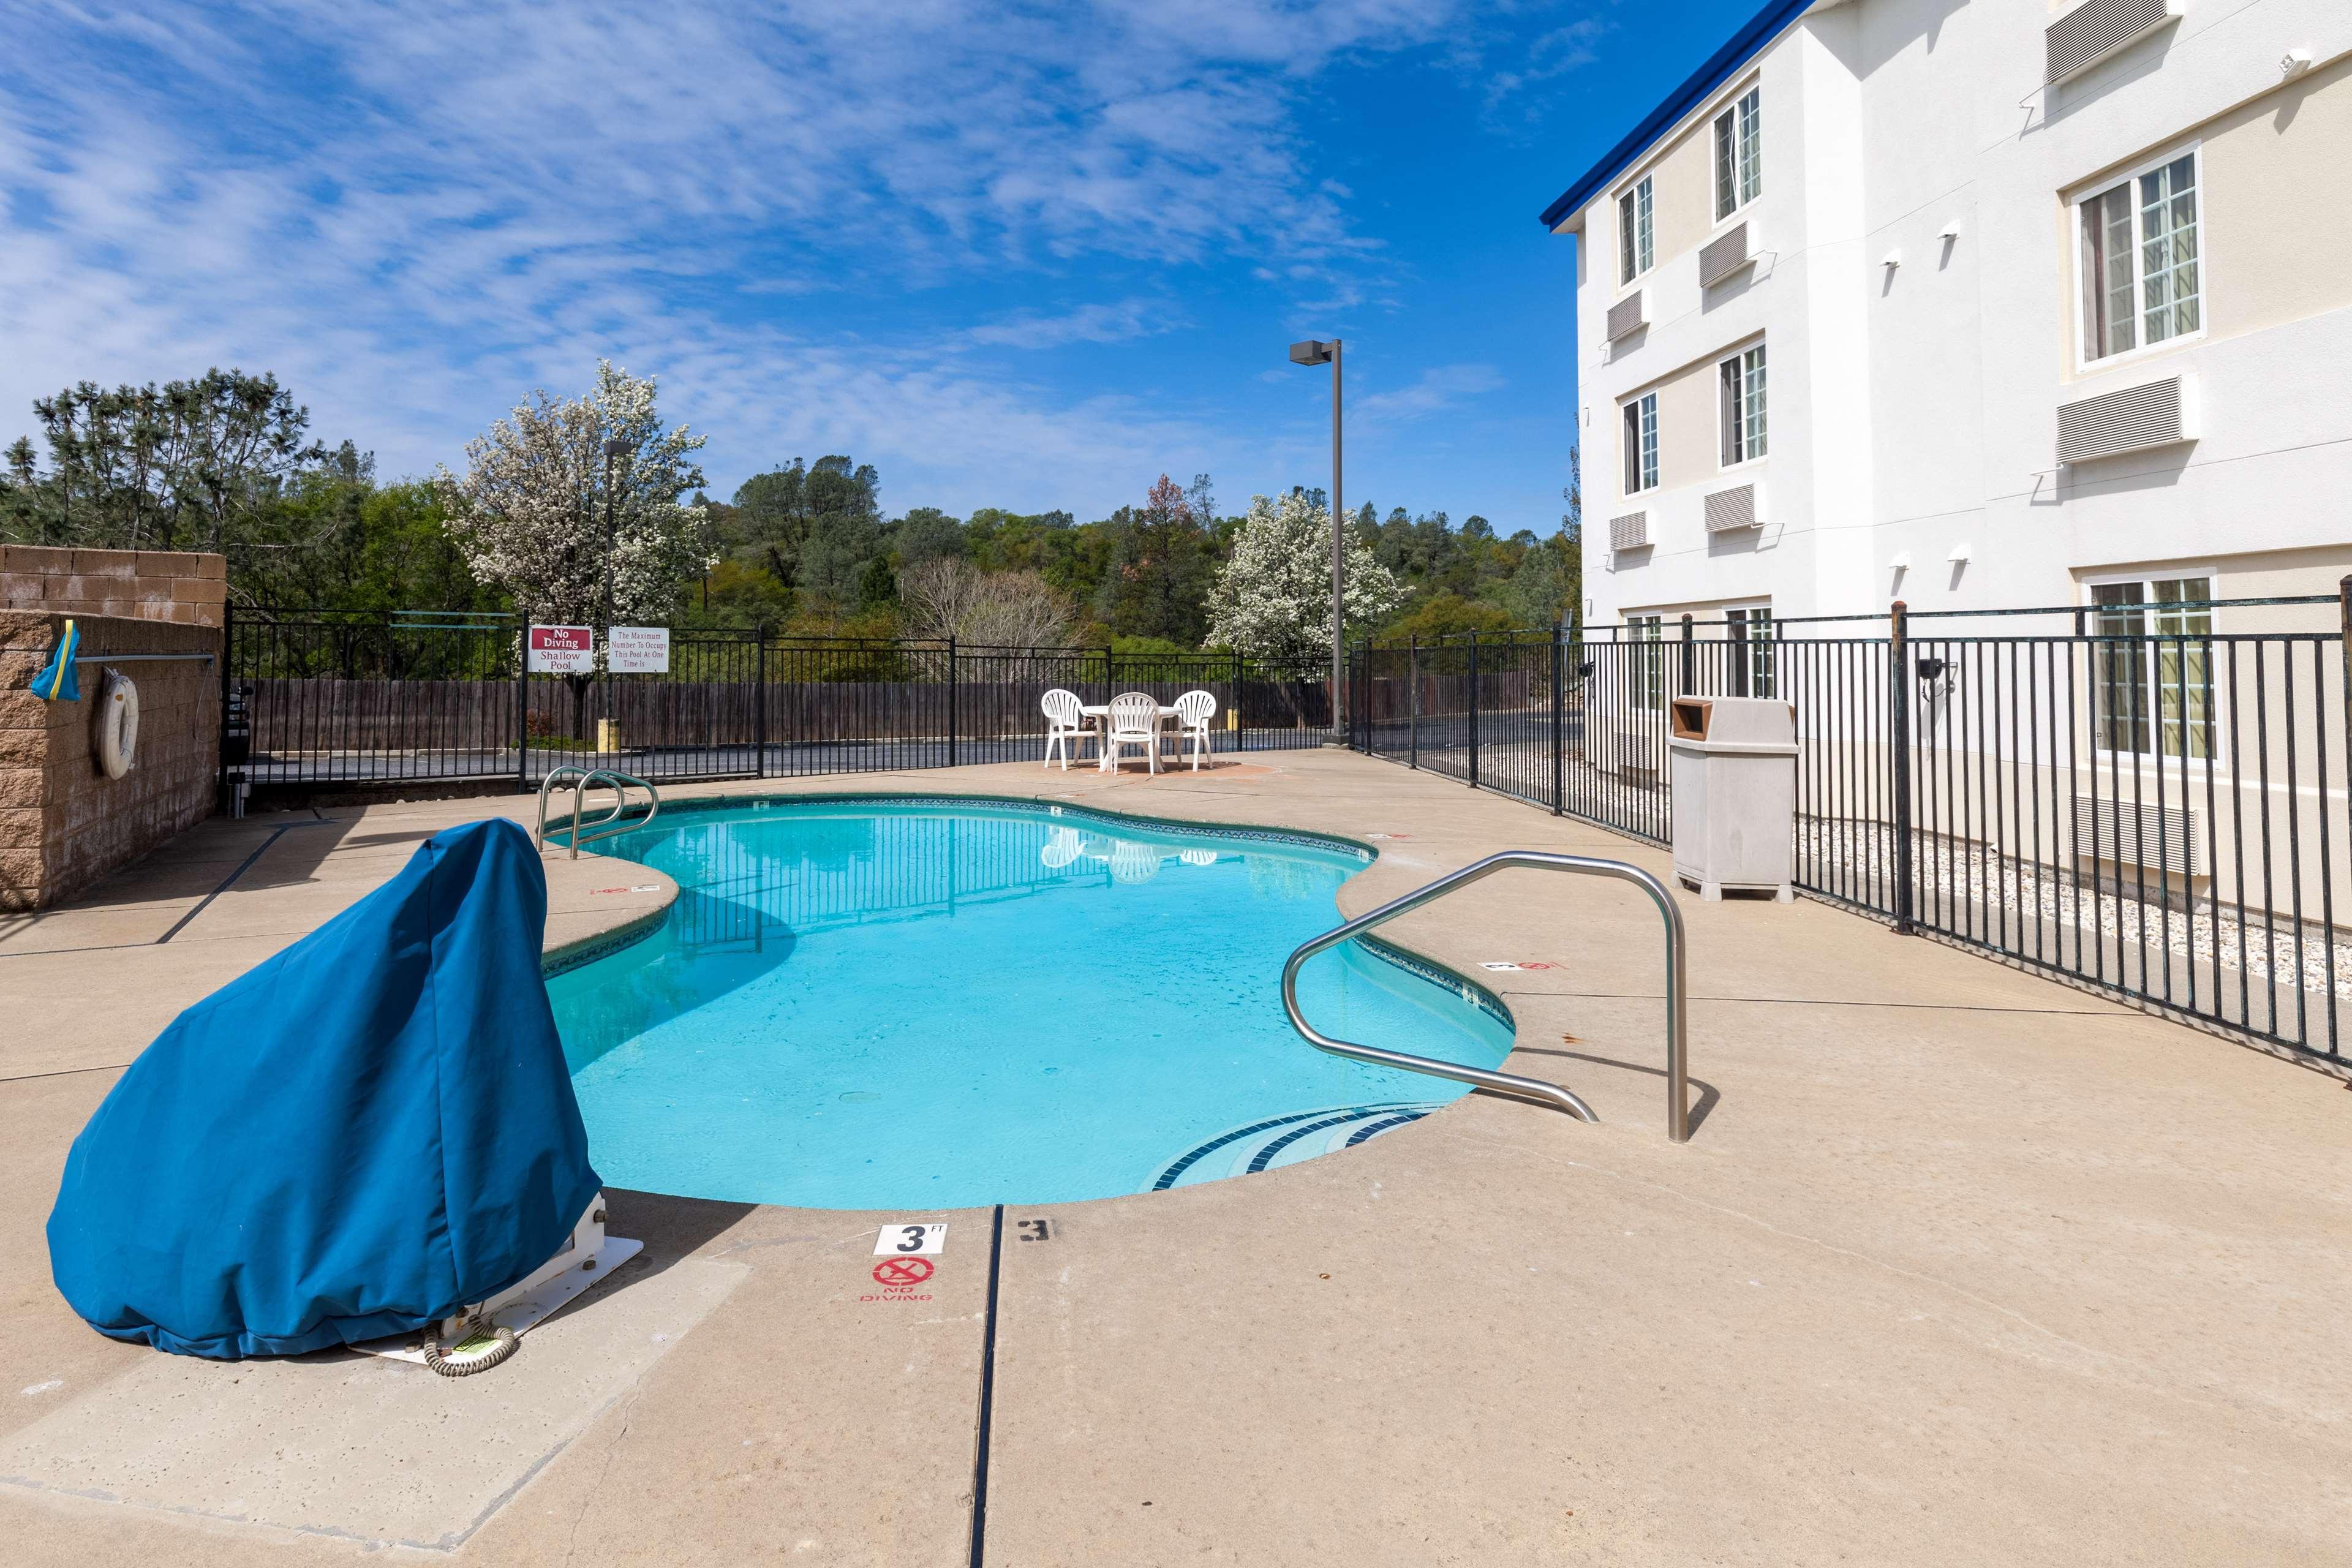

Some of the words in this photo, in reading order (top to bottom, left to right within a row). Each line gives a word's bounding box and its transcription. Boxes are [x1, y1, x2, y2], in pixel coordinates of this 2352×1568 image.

[554, 629, 569, 638] No
[543, 637, 579, 649] Diving
[540, 651, 580, 660] Shallow
[1018, 1220, 1049, 1242] 3
[897, 1226, 925, 1252] 3
